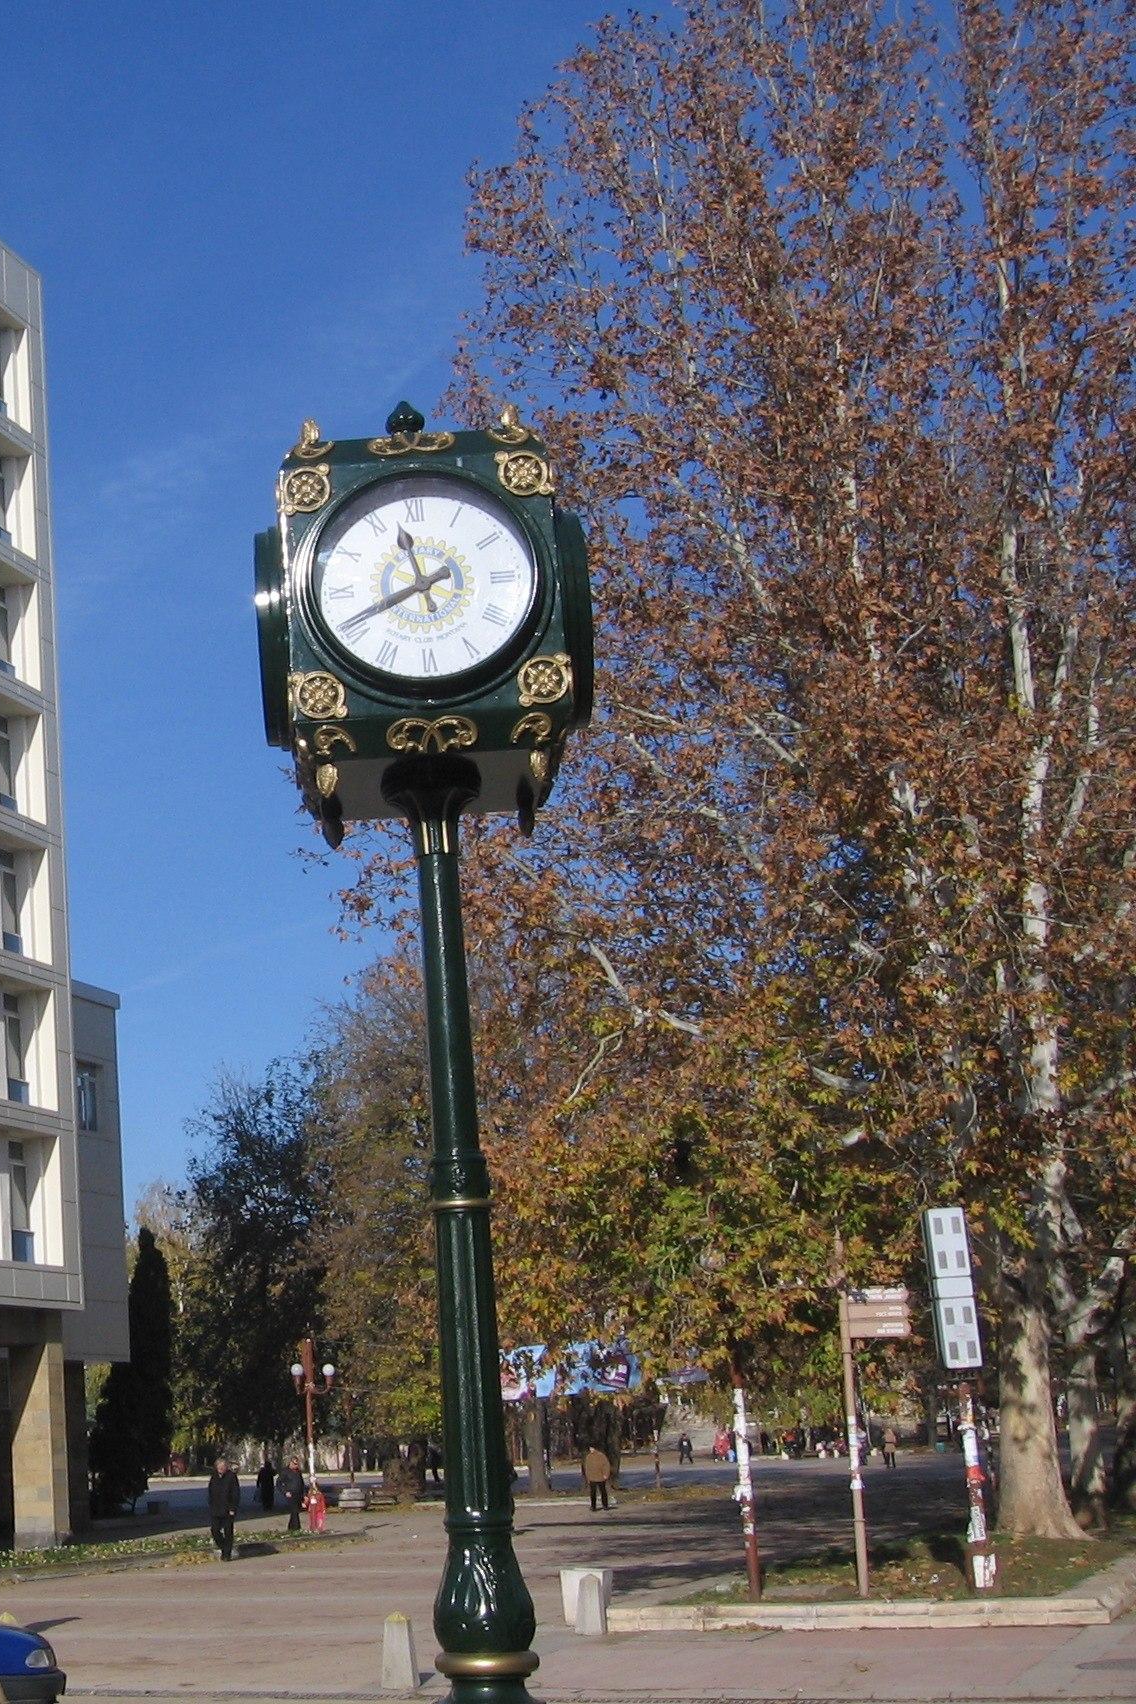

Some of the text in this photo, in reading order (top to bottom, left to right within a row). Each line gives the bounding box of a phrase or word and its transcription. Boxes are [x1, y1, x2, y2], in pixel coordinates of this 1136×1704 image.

[405, 499, 425, 523] XII
[364, 510, 388, 537] XI
[475, 532, 501, 551] II
[336, 545, 362, 564] X
[490, 569, 516, 585] III
[329, 584, 355, 600] IX
[390, 593, 464, 624] NTERNATIONAL
[375, 640, 399, 669] VII
[461, 636, 481, 659] V
[422, 648, 439, 673] VI
